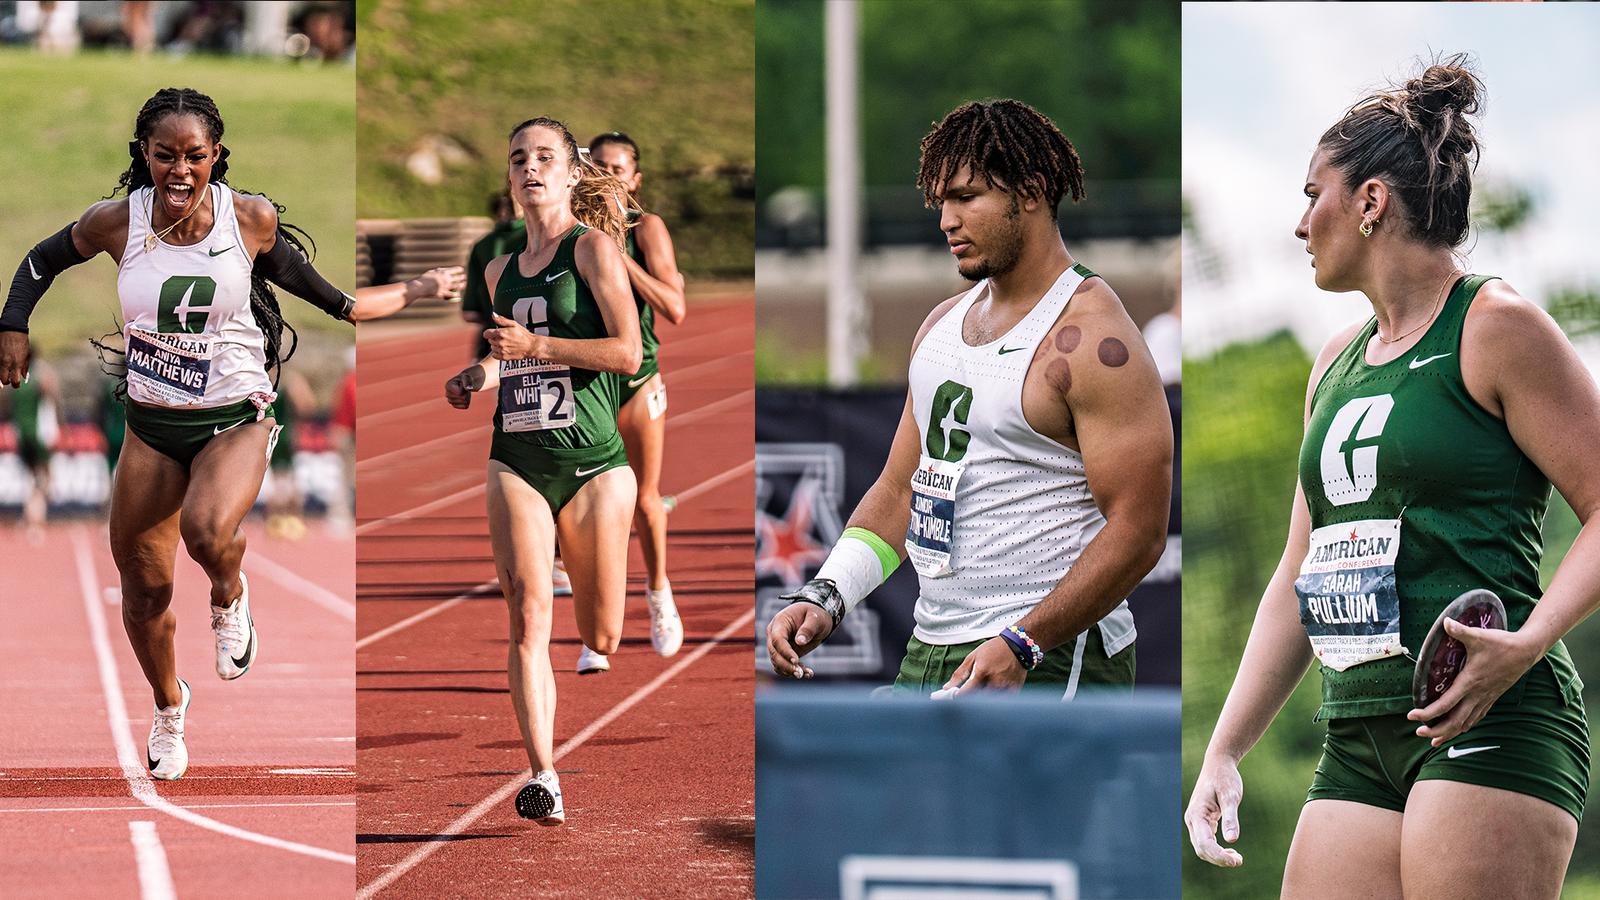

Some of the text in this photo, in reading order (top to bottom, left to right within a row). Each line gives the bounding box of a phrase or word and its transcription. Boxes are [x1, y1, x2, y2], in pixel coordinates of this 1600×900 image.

[130, 348, 204, 388] MATTHEWS
[154, 349, 181, 365] ANIYA
[522, 374, 541, 387] ELLA
[547, 380, 568, 421] 2
[1310, 537, 1392, 564] AMERICAN
[1337, 558, 1383, 569] CONFERENCE
[1322, 572, 1361, 594] SARAH
[1307, 593, 1379, 624] PULLIUM
